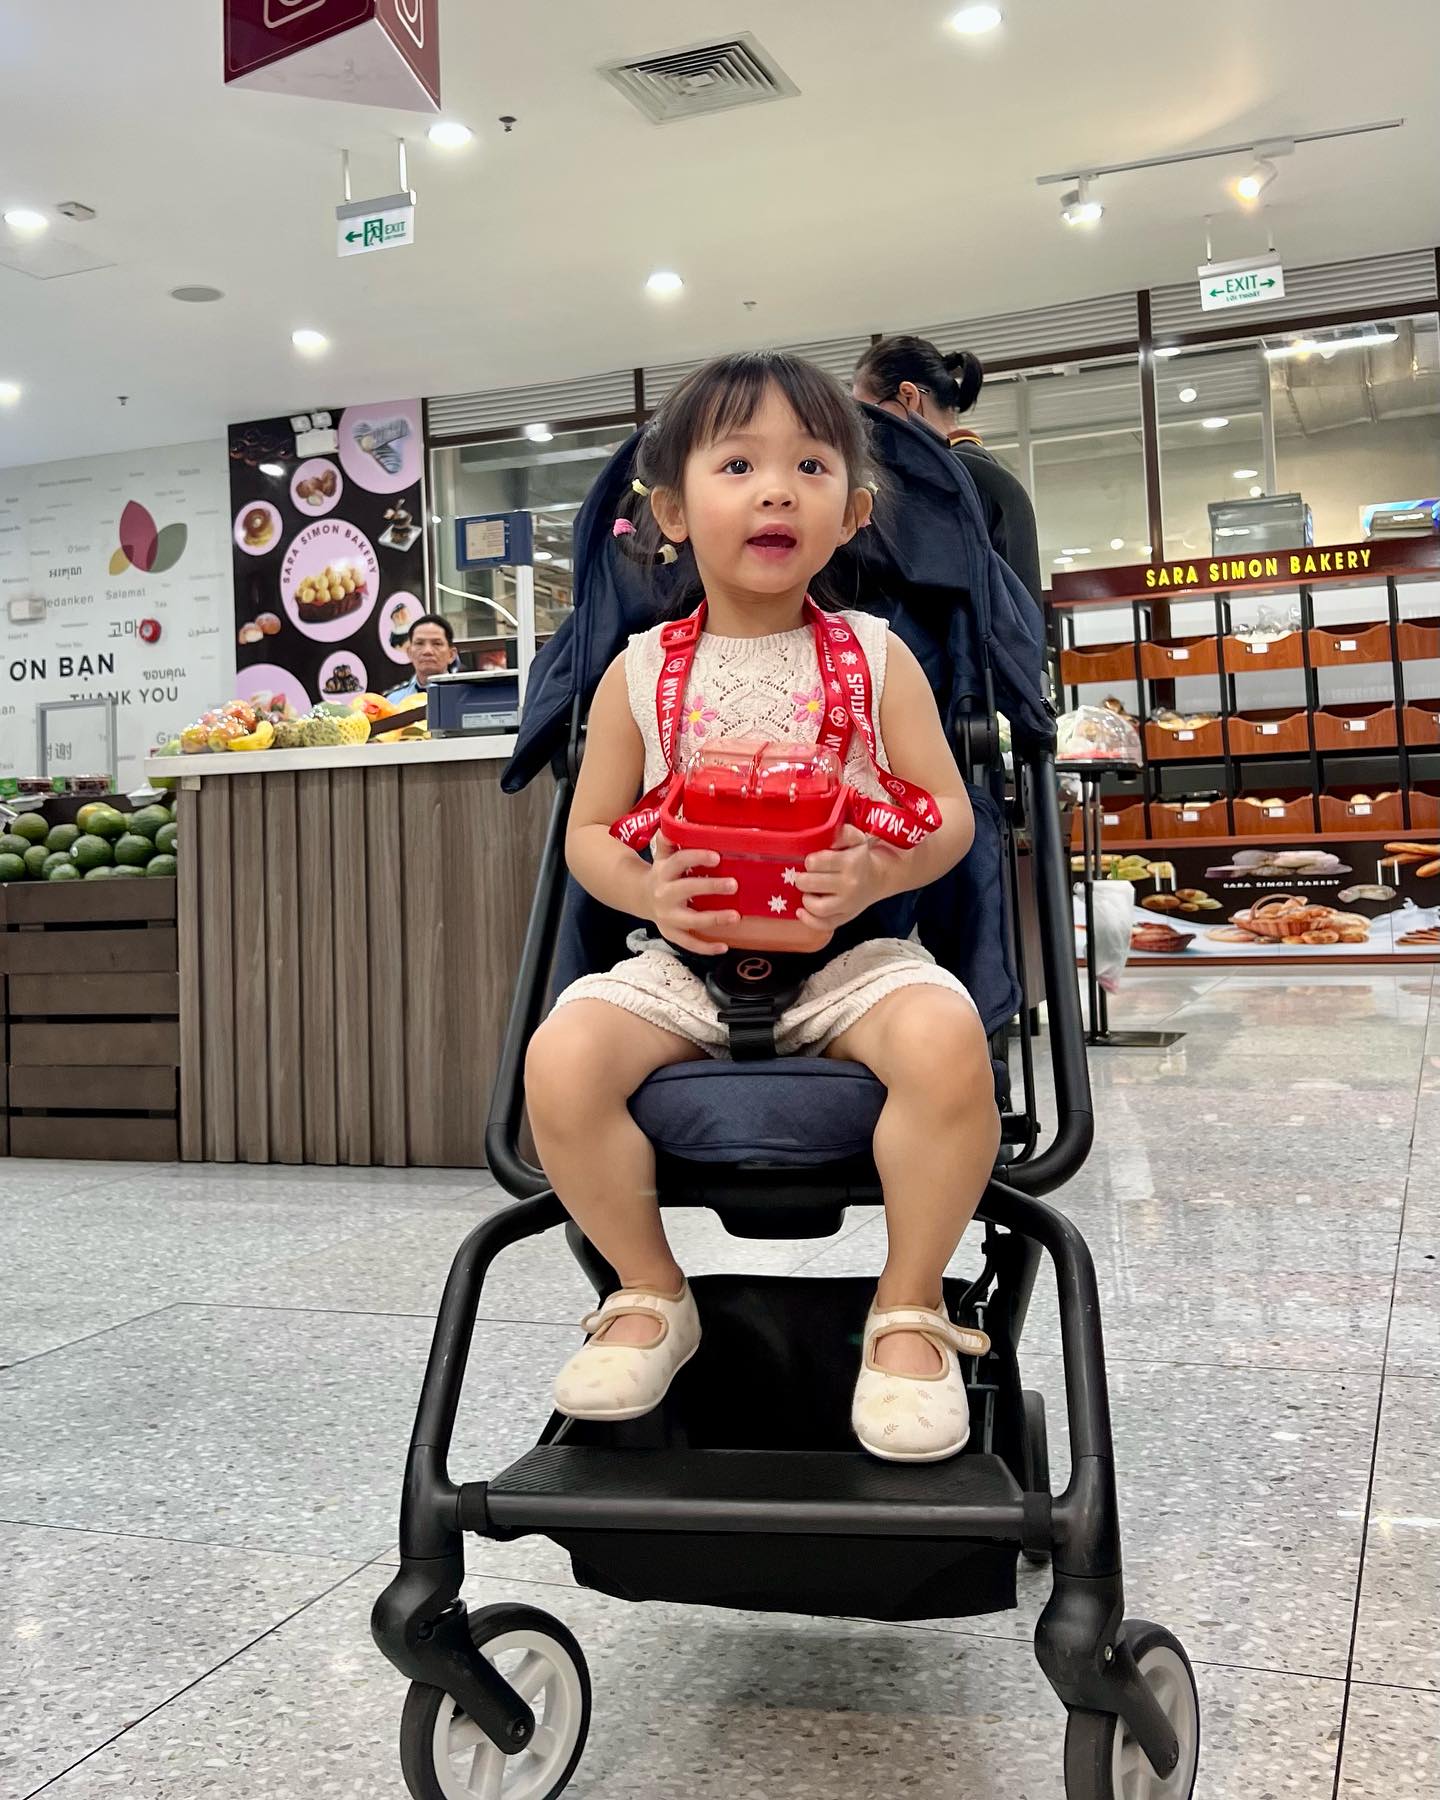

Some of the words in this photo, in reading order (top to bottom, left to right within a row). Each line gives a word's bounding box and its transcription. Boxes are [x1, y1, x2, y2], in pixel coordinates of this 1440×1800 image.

[385, 221, 406, 235] EXIT
[1226, 275, 1258, 293] EXIT
[283, 548, 299, 583] SARA
[301, 525, 339, 545] SIMON
[345, 529, 377, 574] BAKERY
[1146, 565, 1198, 588] SARA
[1209, 557, 1278, 582] SIMON
[1290, 549, 1371, 574] BAKERY
[46, 595, 94, 609] edanken
[108, 619, 140, 639] 고마
[10, 658, 46, 682] ƠN
[59, 653, 114, 682] BẠN
[143, 667, 186, 681] ขอบคุณ
[139, 686, 178, 703] YOU
